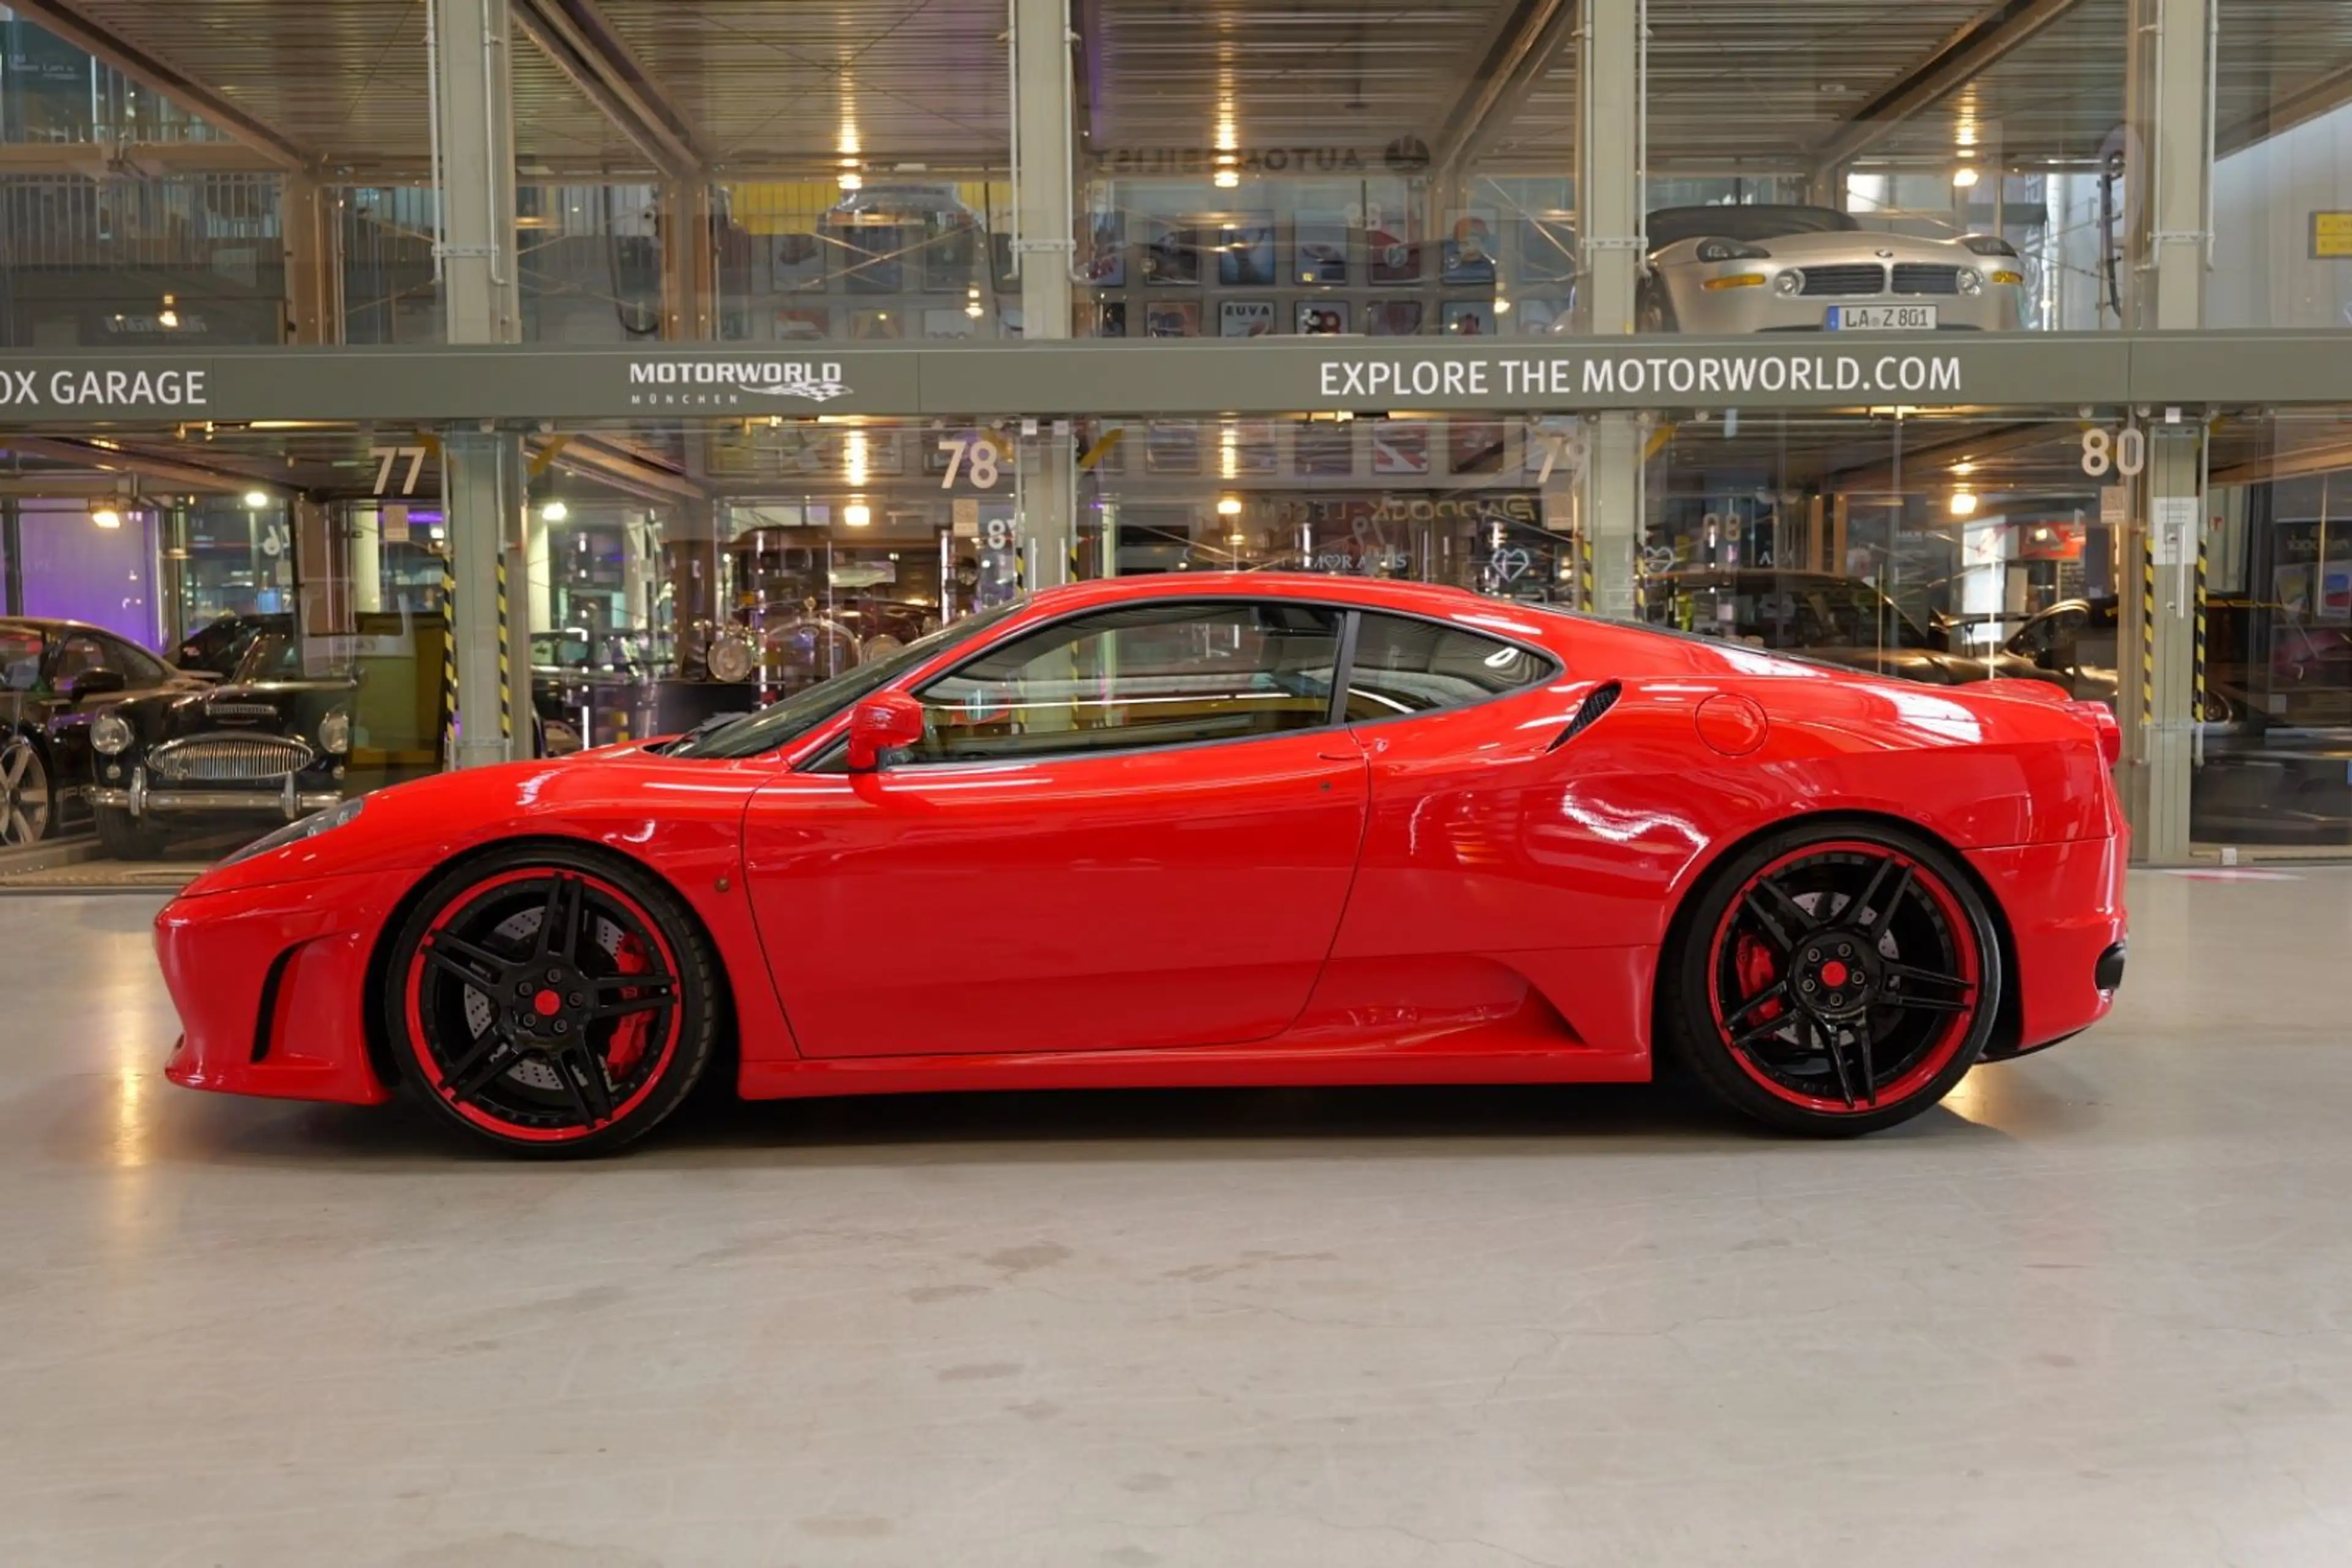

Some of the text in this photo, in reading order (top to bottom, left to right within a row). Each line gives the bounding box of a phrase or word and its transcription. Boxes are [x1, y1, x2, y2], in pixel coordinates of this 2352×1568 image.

[1845, 309, 1928, 327] LA Z 801
[50, 370, 206, 404] GARAGE
[630, 362, 842, 383] MOTORWORLD
[1321, 355, 1961, 395] EXPLORE THE MOTORWORLD.COM
[631, 393, 737, 404] MÜNCHEN
[368, 446, 427, 495] 77
[938, 440, 998, 489] 78
[1534, 436, 1591, 488] 79
[2081, 428, 2145, 477] 80
